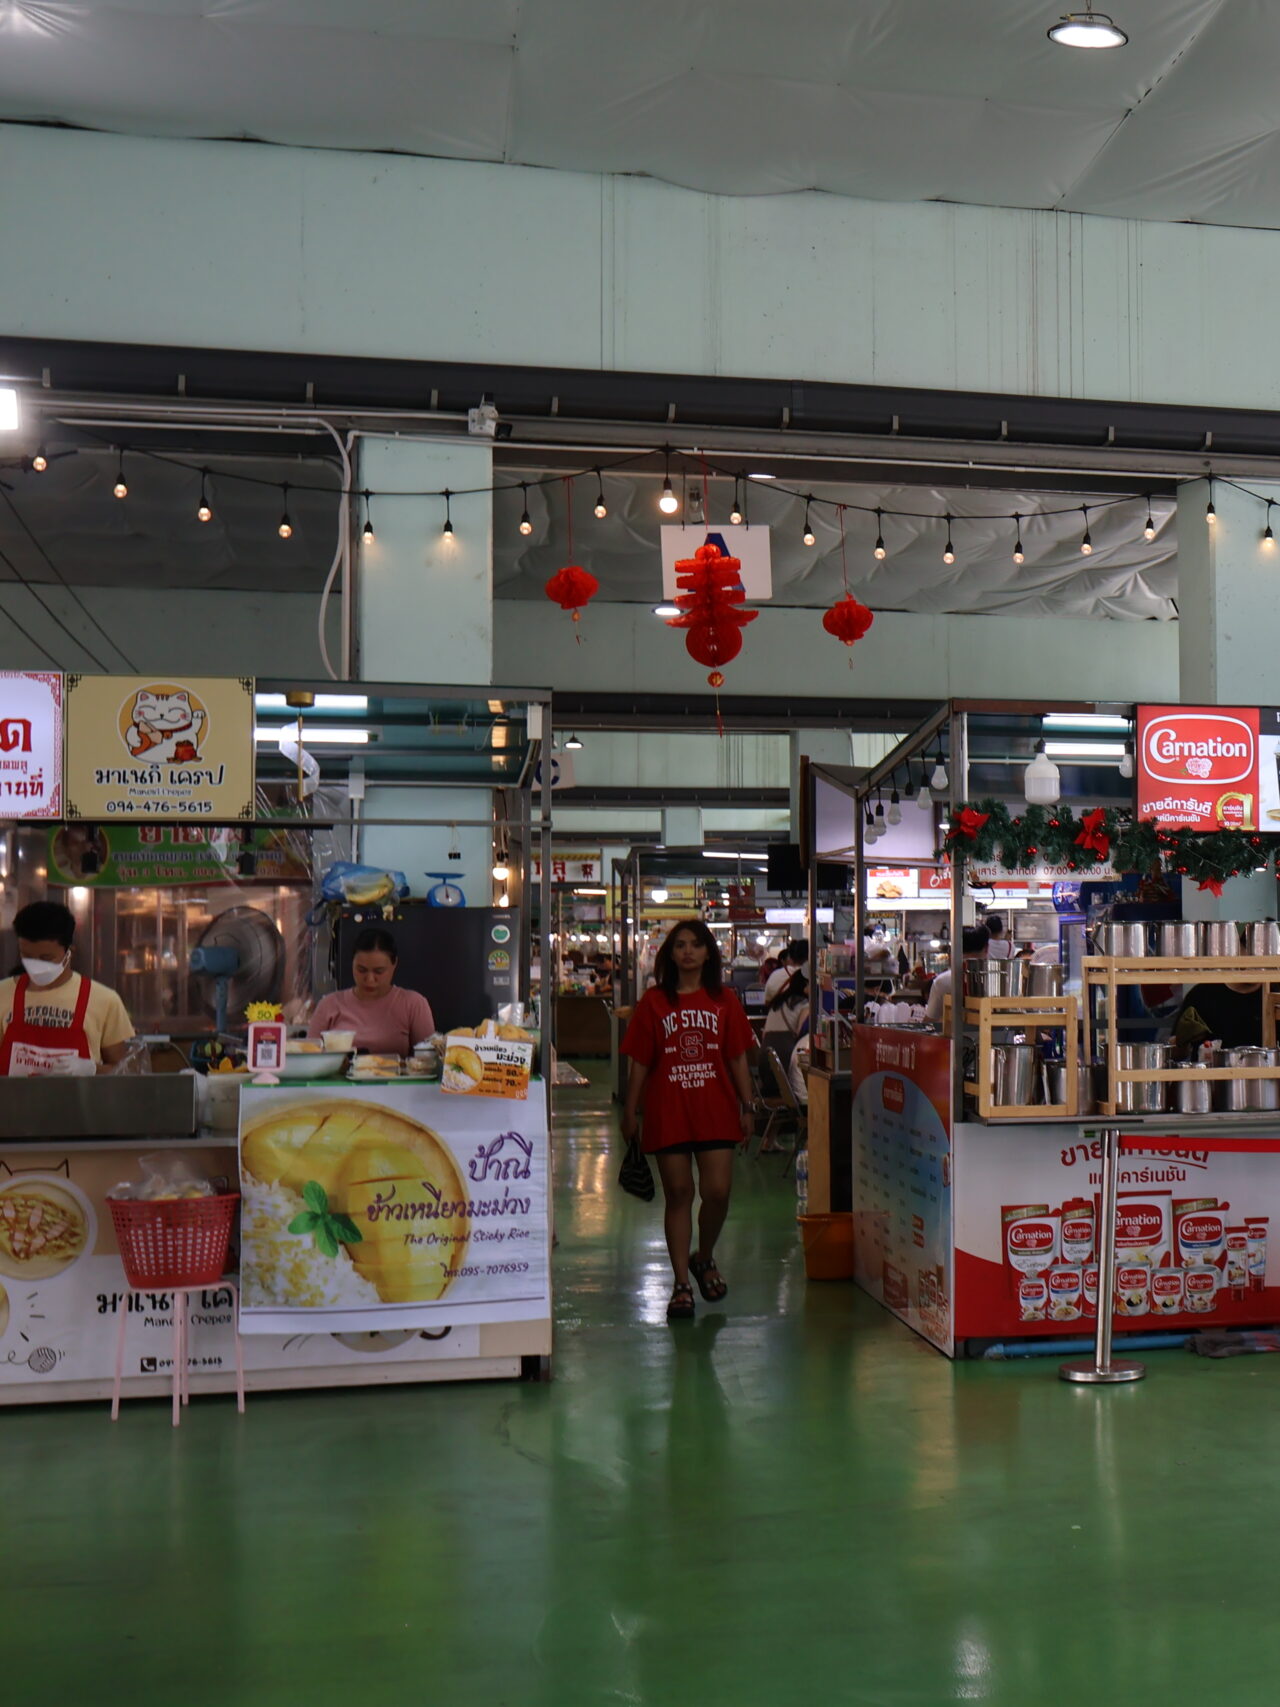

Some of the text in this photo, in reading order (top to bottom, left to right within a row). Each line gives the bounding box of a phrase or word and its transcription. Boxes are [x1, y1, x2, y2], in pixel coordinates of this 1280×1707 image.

[1150, 729, 1247, 764] Carnation
[96, 764, 225, 785] มาเนกิ เครป
[106, 801, 212, 813] 094-476-5615
[978, 864, 998, 876] เสาร์
[1007, 864, 1037, 876] อาทิตย์
[1043, 866, 1068, 876] 07.00
[1078, 866, 1101, 876] 20.00
[662, 1009, 719, 1039] NC STATE
[496, 1052, 526, 1065] มะม่วง
[672, 1063, 714, 1074] STUDENT
[669, 1071, 717, 1083] WOLFPACK
[682, 1080, 705, 1089] CLUB
[367, 1181, 531, 1222] ข้าวเหนียวมะม่วง
[1012, 1228, 1052, 1243] Carnation
[1182, 1222, 1221, 1236] Carnation
[403, 1227, 530, 1247] The Original Sticky Rice
[96, 1290, 190, 1314] มาเน
